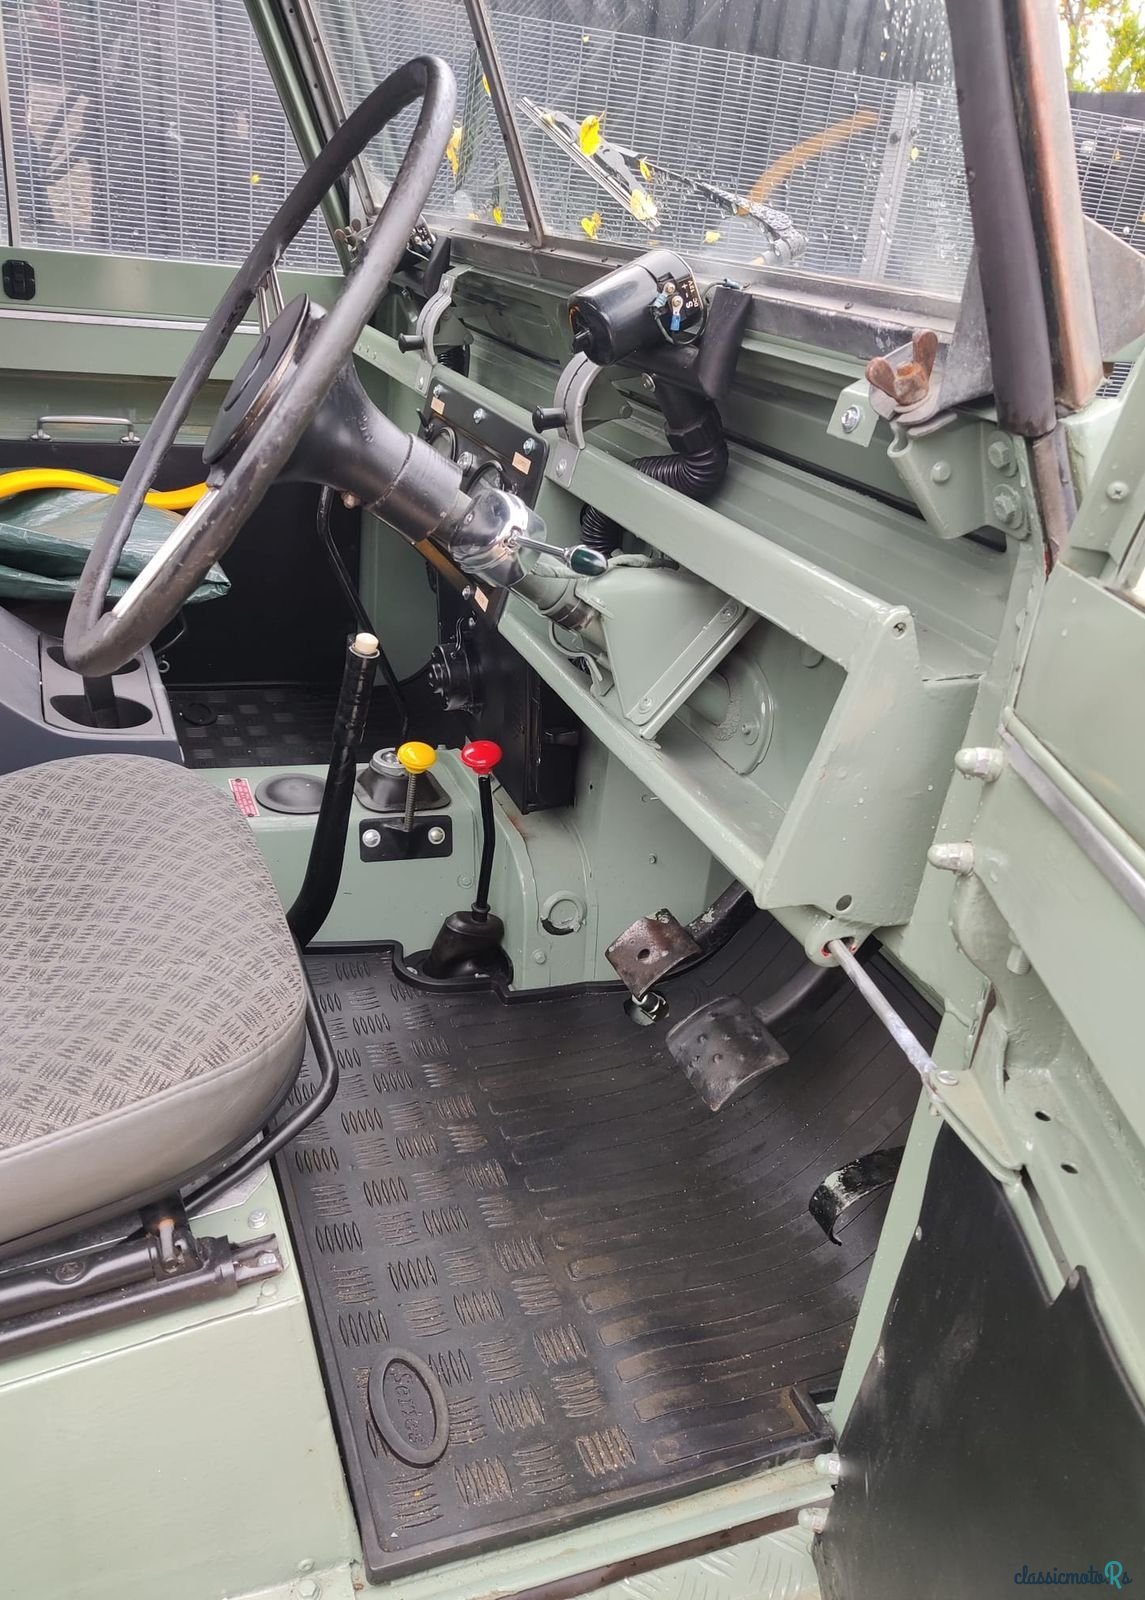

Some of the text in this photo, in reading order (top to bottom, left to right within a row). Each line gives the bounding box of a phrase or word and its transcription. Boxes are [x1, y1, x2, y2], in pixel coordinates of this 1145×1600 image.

[687, 280, 699, 308] DC 12V
[389, 1370, 423, 1442] Series
